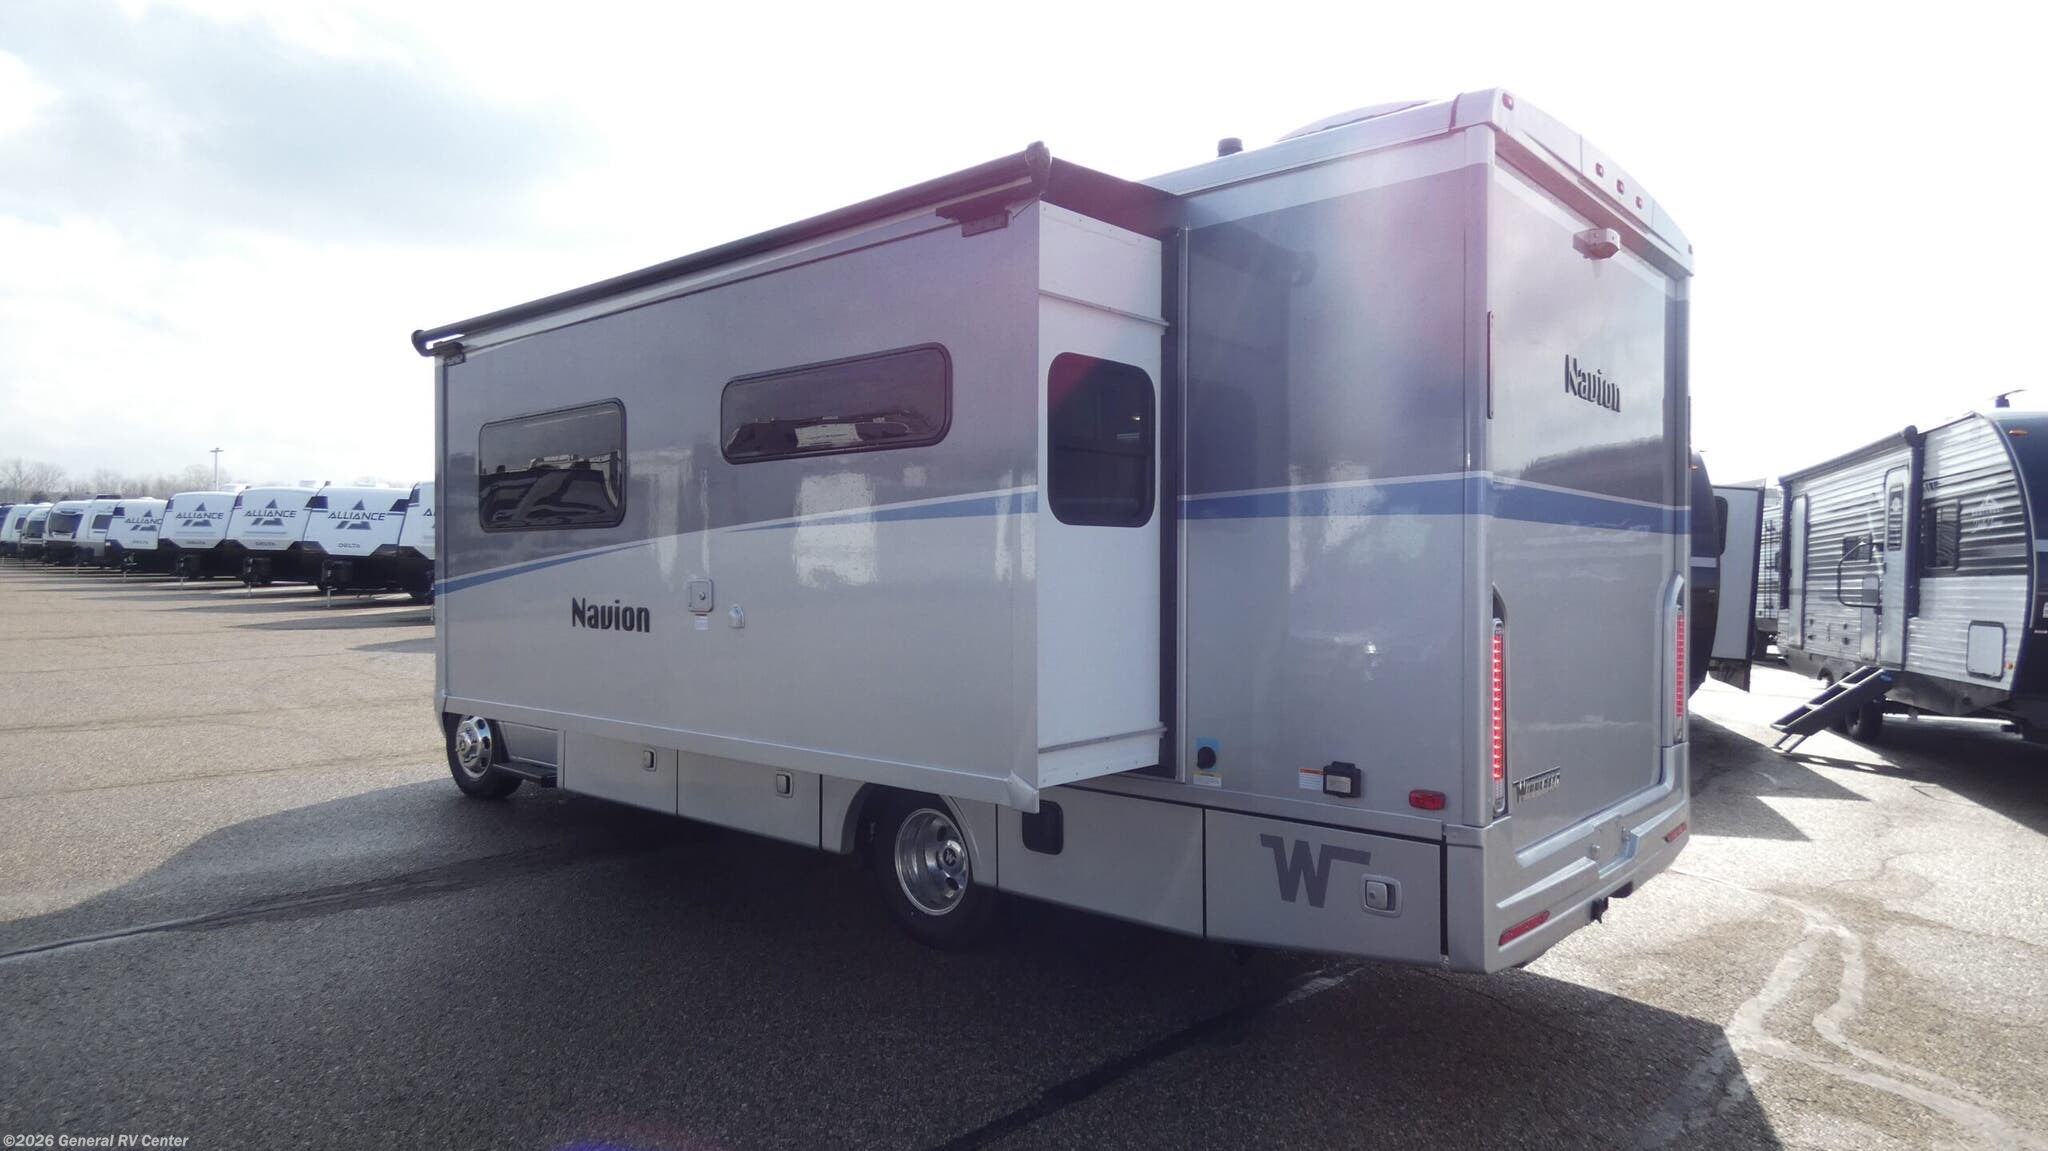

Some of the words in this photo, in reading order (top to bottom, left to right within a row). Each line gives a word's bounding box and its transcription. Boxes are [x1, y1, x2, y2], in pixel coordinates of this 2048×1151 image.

[1565, 354, 1621, 412] Navion
[244, 510, 298, 518] ALLIANCE
[327, 511, 386, 521] ALLIANCE
[571, 596, 650, 633] Navion
